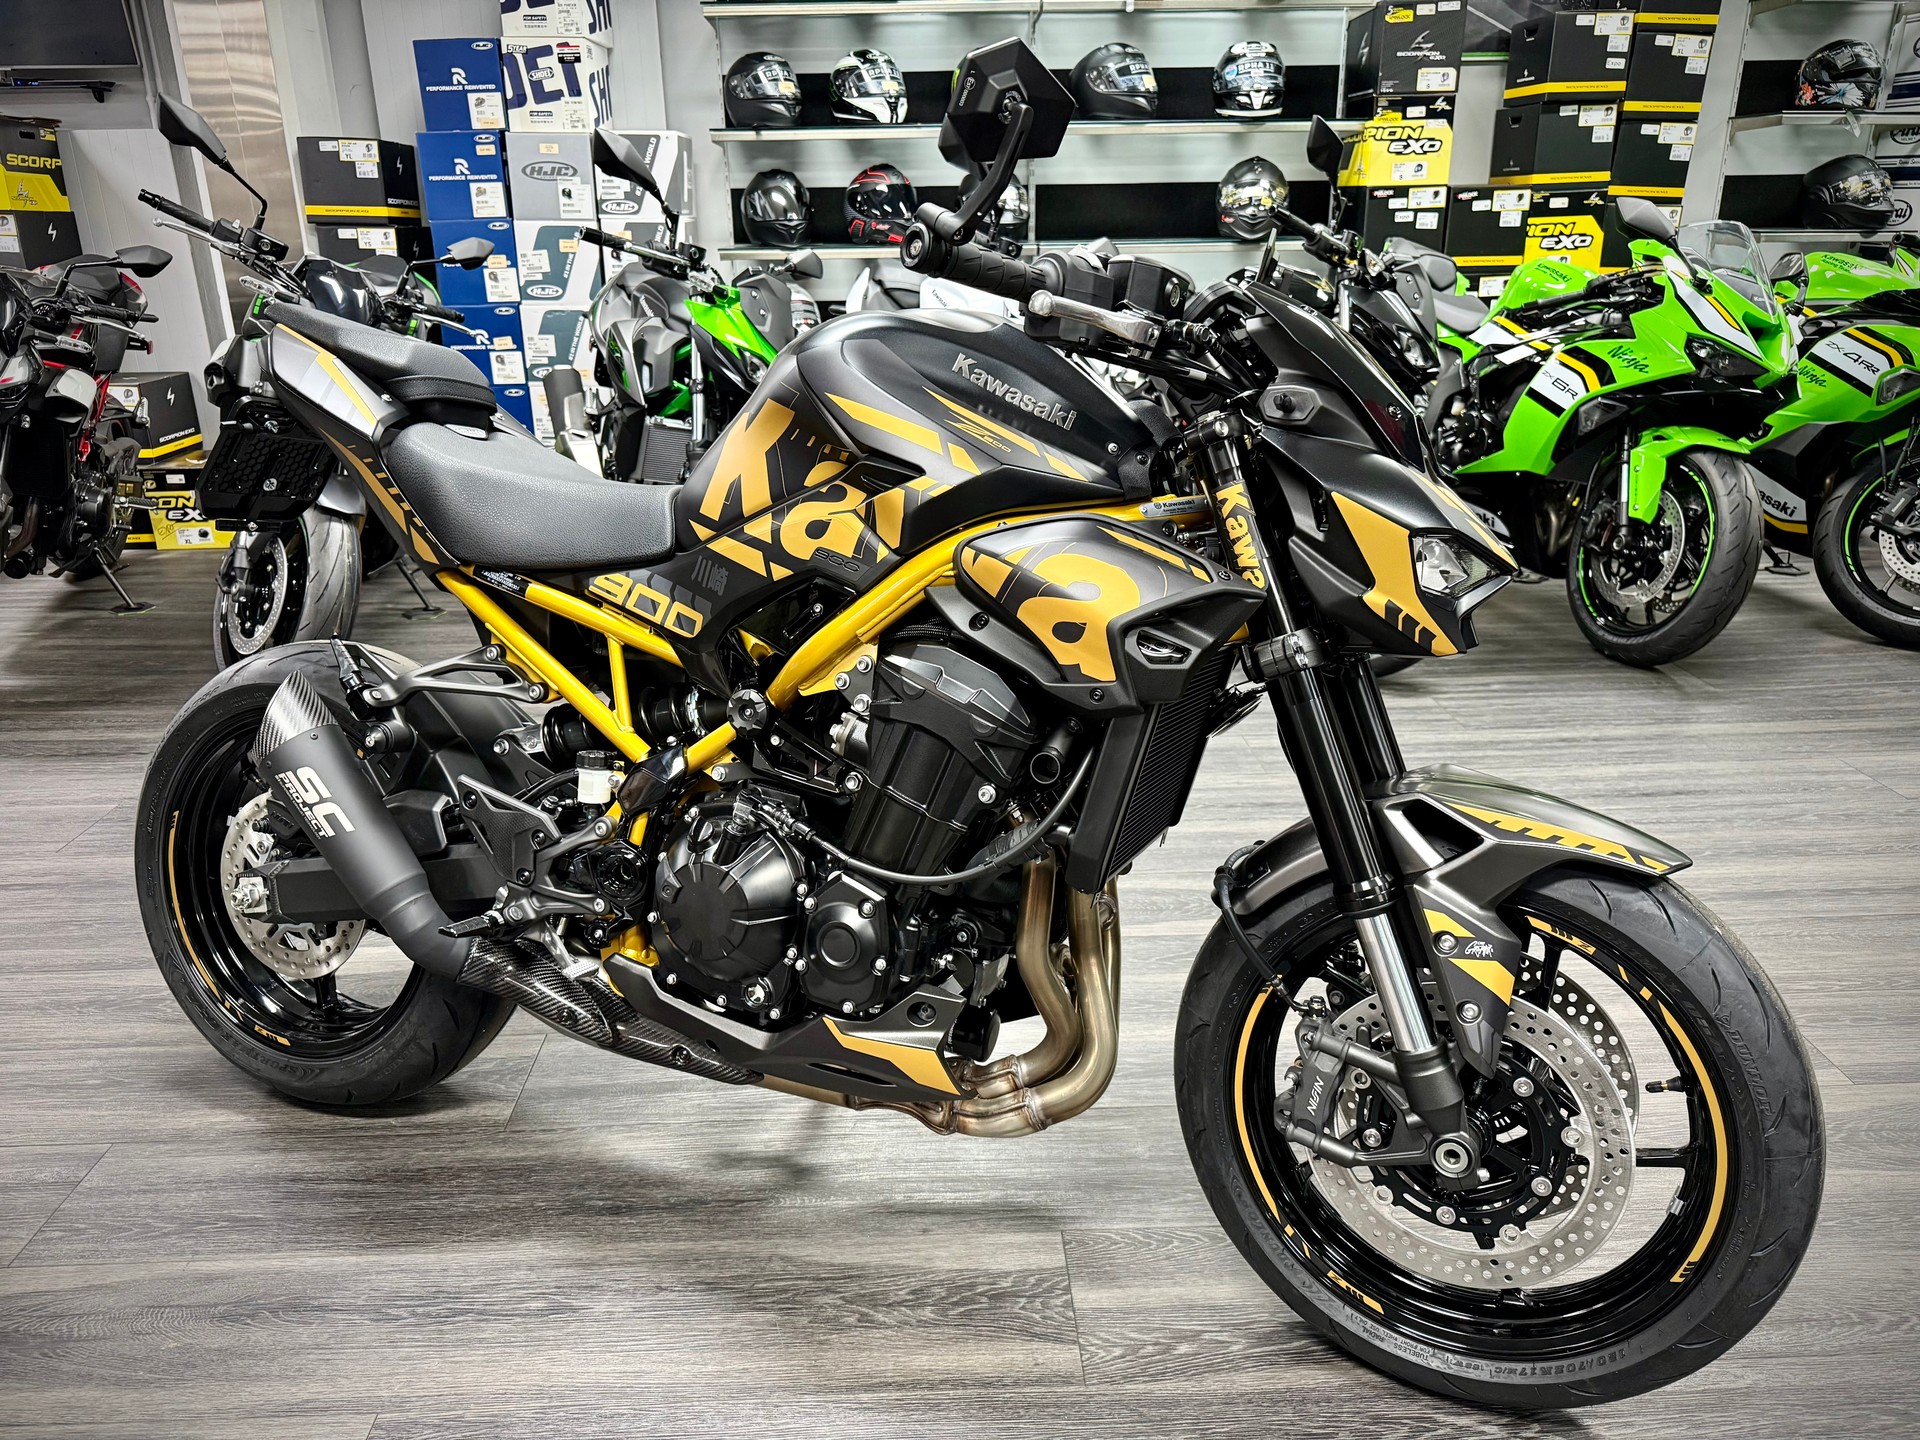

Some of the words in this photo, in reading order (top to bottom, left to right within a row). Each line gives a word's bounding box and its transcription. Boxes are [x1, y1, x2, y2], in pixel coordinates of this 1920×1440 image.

[529, 166, 570, 177] HJC
[606, 202, 635, 212] HJC
[1608, 345, 1649, 374] Ninja
[952, 352, 1078, 431] Kawasaki
[1162, 499, 1196, 508] Kawasaki
[588, 573, 704, 638] 900
[278, 772, 328, 838] PROJECT
[285, 766, 356, 838] SC
[1306, 1076, 1325, 1116] NISSIN
[1362, 1326, 1386, 1342] RADIAL
[1393, 1342, 1430, 1362] TUBELESS
